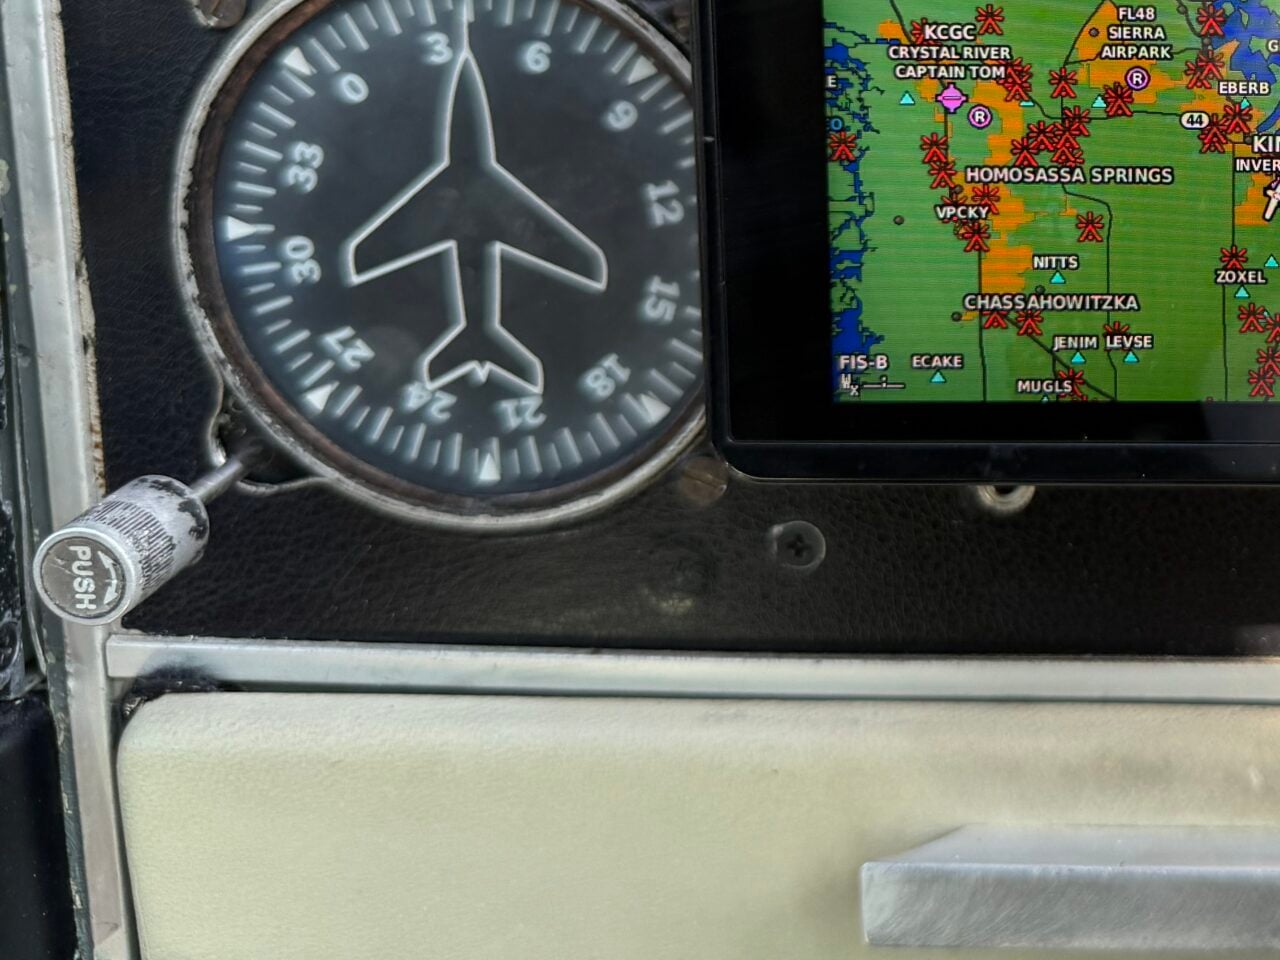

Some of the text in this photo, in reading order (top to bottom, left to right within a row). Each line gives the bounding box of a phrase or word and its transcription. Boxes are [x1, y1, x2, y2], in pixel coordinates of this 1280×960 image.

[1118, 7, 1155, 20] FL48
[924, 25, 976, 40] KCGC
[1109, 27, 1164, 39] SIERRA
[423, 32, 454, 65] 3
[889, 46, 1011, 60] CRYSTAL RIVER
[1101, 46, 1171, 59] AIRPARK
[518, 41, 552, 73] 6
[895, 66, 1006, 79] CAPTAIN TOM
[337, 72, 369, 104] 0
[1219, 82, 1269, 95] EBERB
[603, 100, 638, 131] 9
[1186, 114, 1204, 126] 44
[286, 142, 324, 192] 33
[966, 167, 1173, 184] HOMOSASSA SPRINGS
[644, 179, 684, 227] 12
[936, 207, 988, 219] VPCKY
[284, 235, 322, 283] 30
[1032, 256, 1078, 269] NITTS
[1216, 271, 1265, 283] ZOXEL
[642, 275, 681, 324] 15
[964, 295, 1138, 311] CHASSAHOWITZKA
[320, 326, 375, 370] 27
[1053, 336, 1152, 350] JENIM LEVSE
[840, 354, 888, 369] FIS-B
[912, 355, 963, 367] ECAKE
[583, 352, 633, 401] 18
[1018, 380, 1072, 393] MUGLS
[403, 381, 457, 422] 24
[500, 396, 547, 431] 21
[68, 545, 97, 610] PUSH
